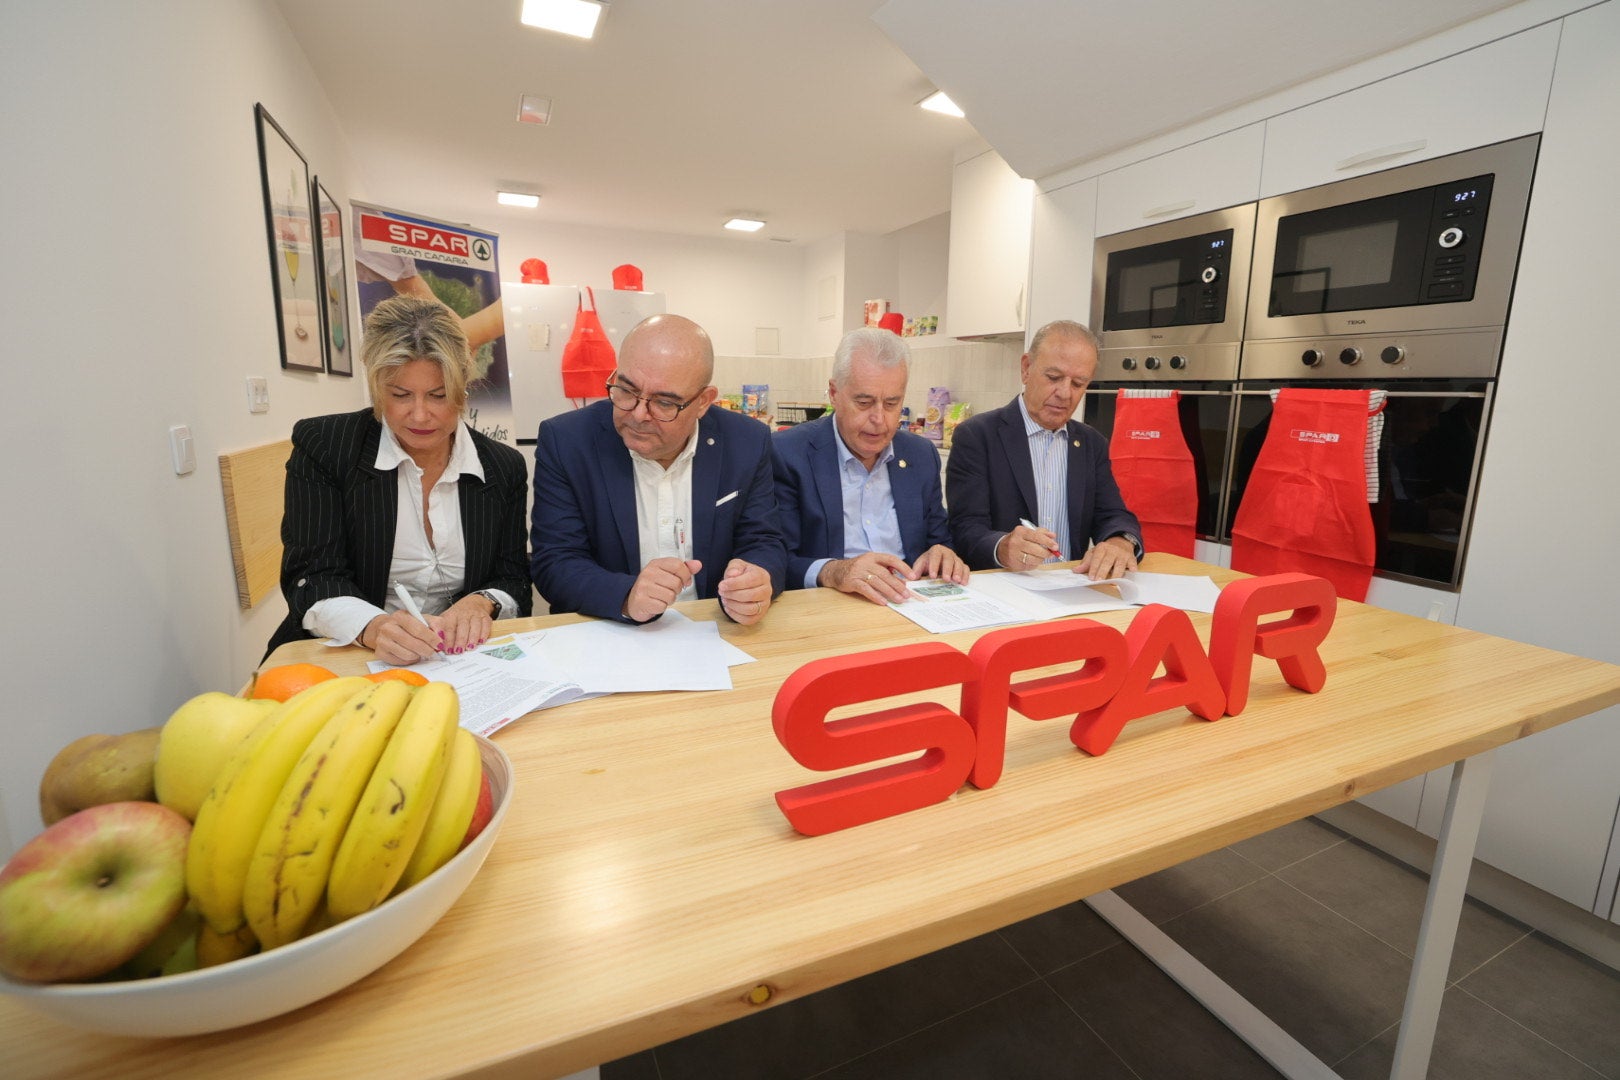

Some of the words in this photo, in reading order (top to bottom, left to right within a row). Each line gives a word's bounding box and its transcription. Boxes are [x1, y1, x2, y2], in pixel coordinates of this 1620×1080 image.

[388, 223, 468, 254] SPAR
[390, 246, 422, 258] GRAN
[424, 252, 469, 265] CANARIA
[771, 571, 1337, 837] SPAR
